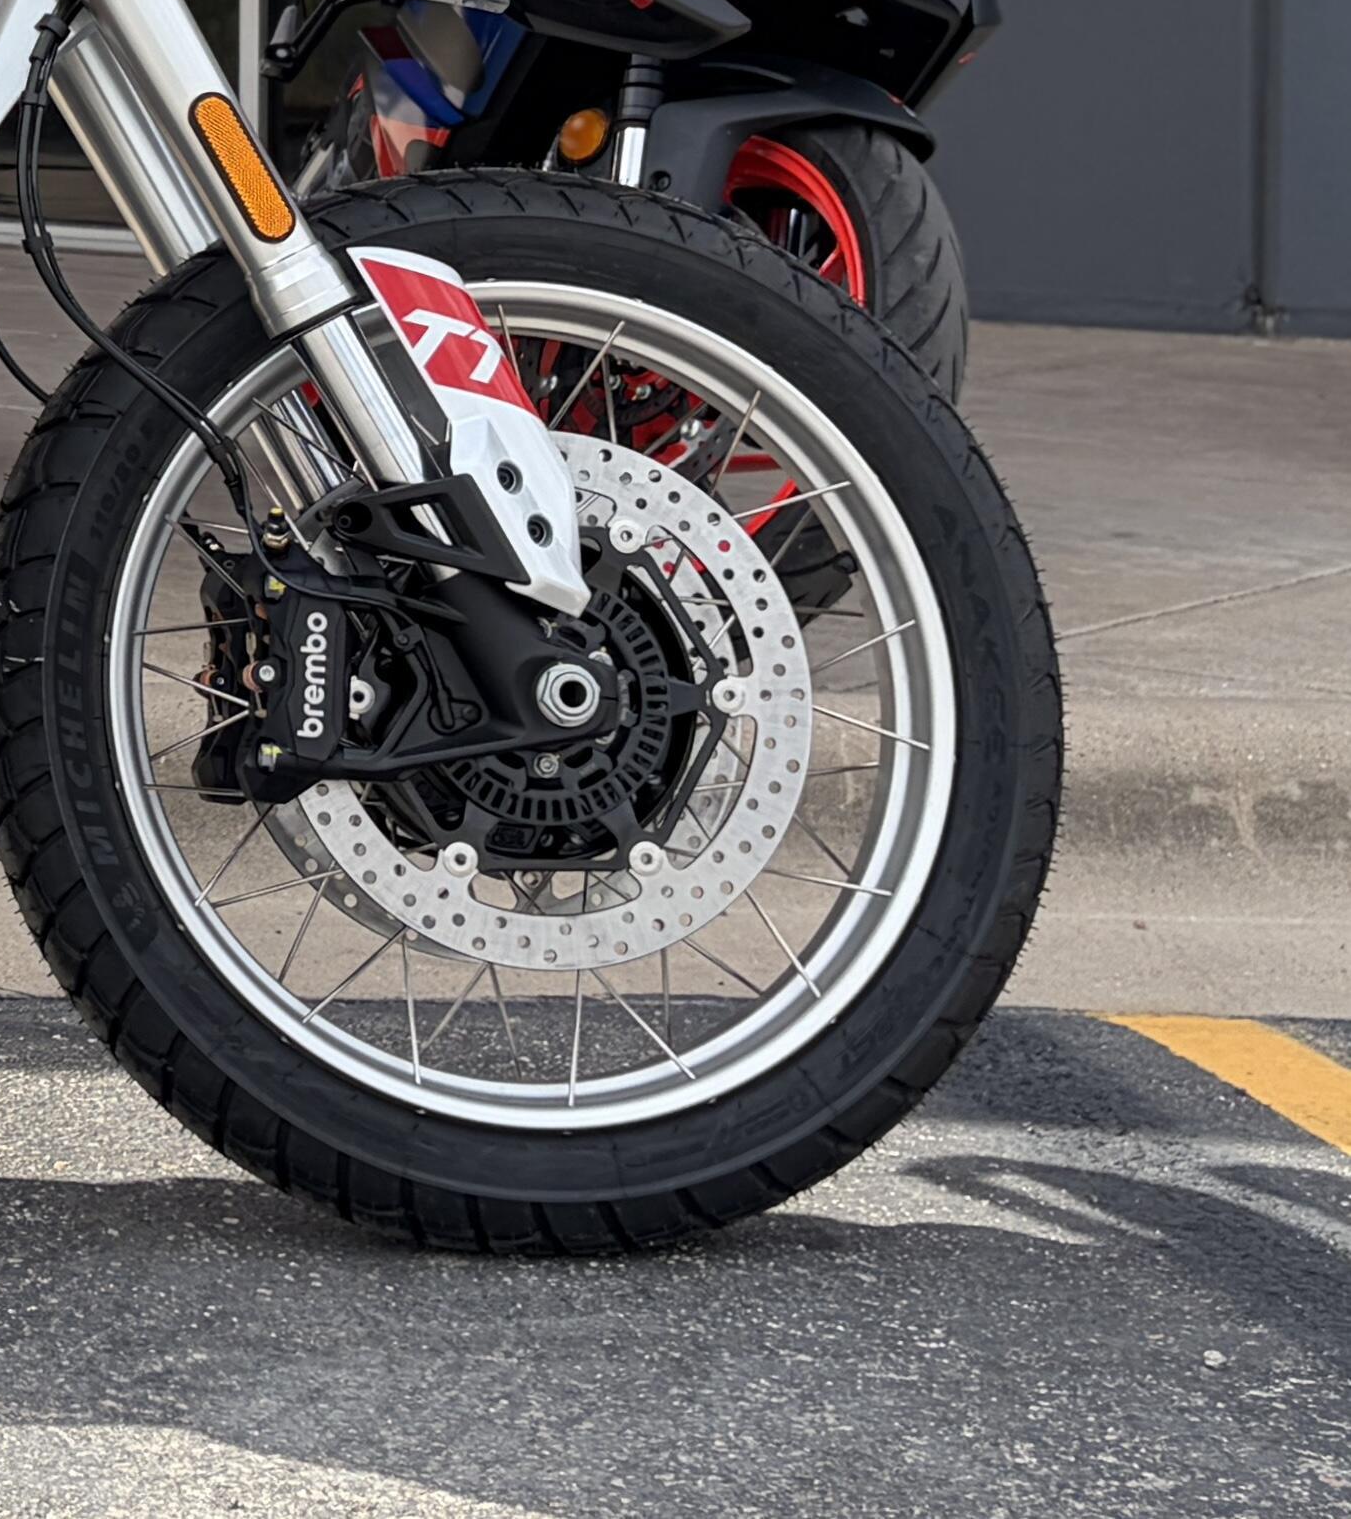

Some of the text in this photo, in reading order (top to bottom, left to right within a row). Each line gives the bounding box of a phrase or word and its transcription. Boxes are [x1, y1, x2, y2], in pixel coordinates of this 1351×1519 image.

[401, 308, 505, 384] TT
[59, 573, 120, 866] MICHELIN
[297, 612, 328, 738] brembo
